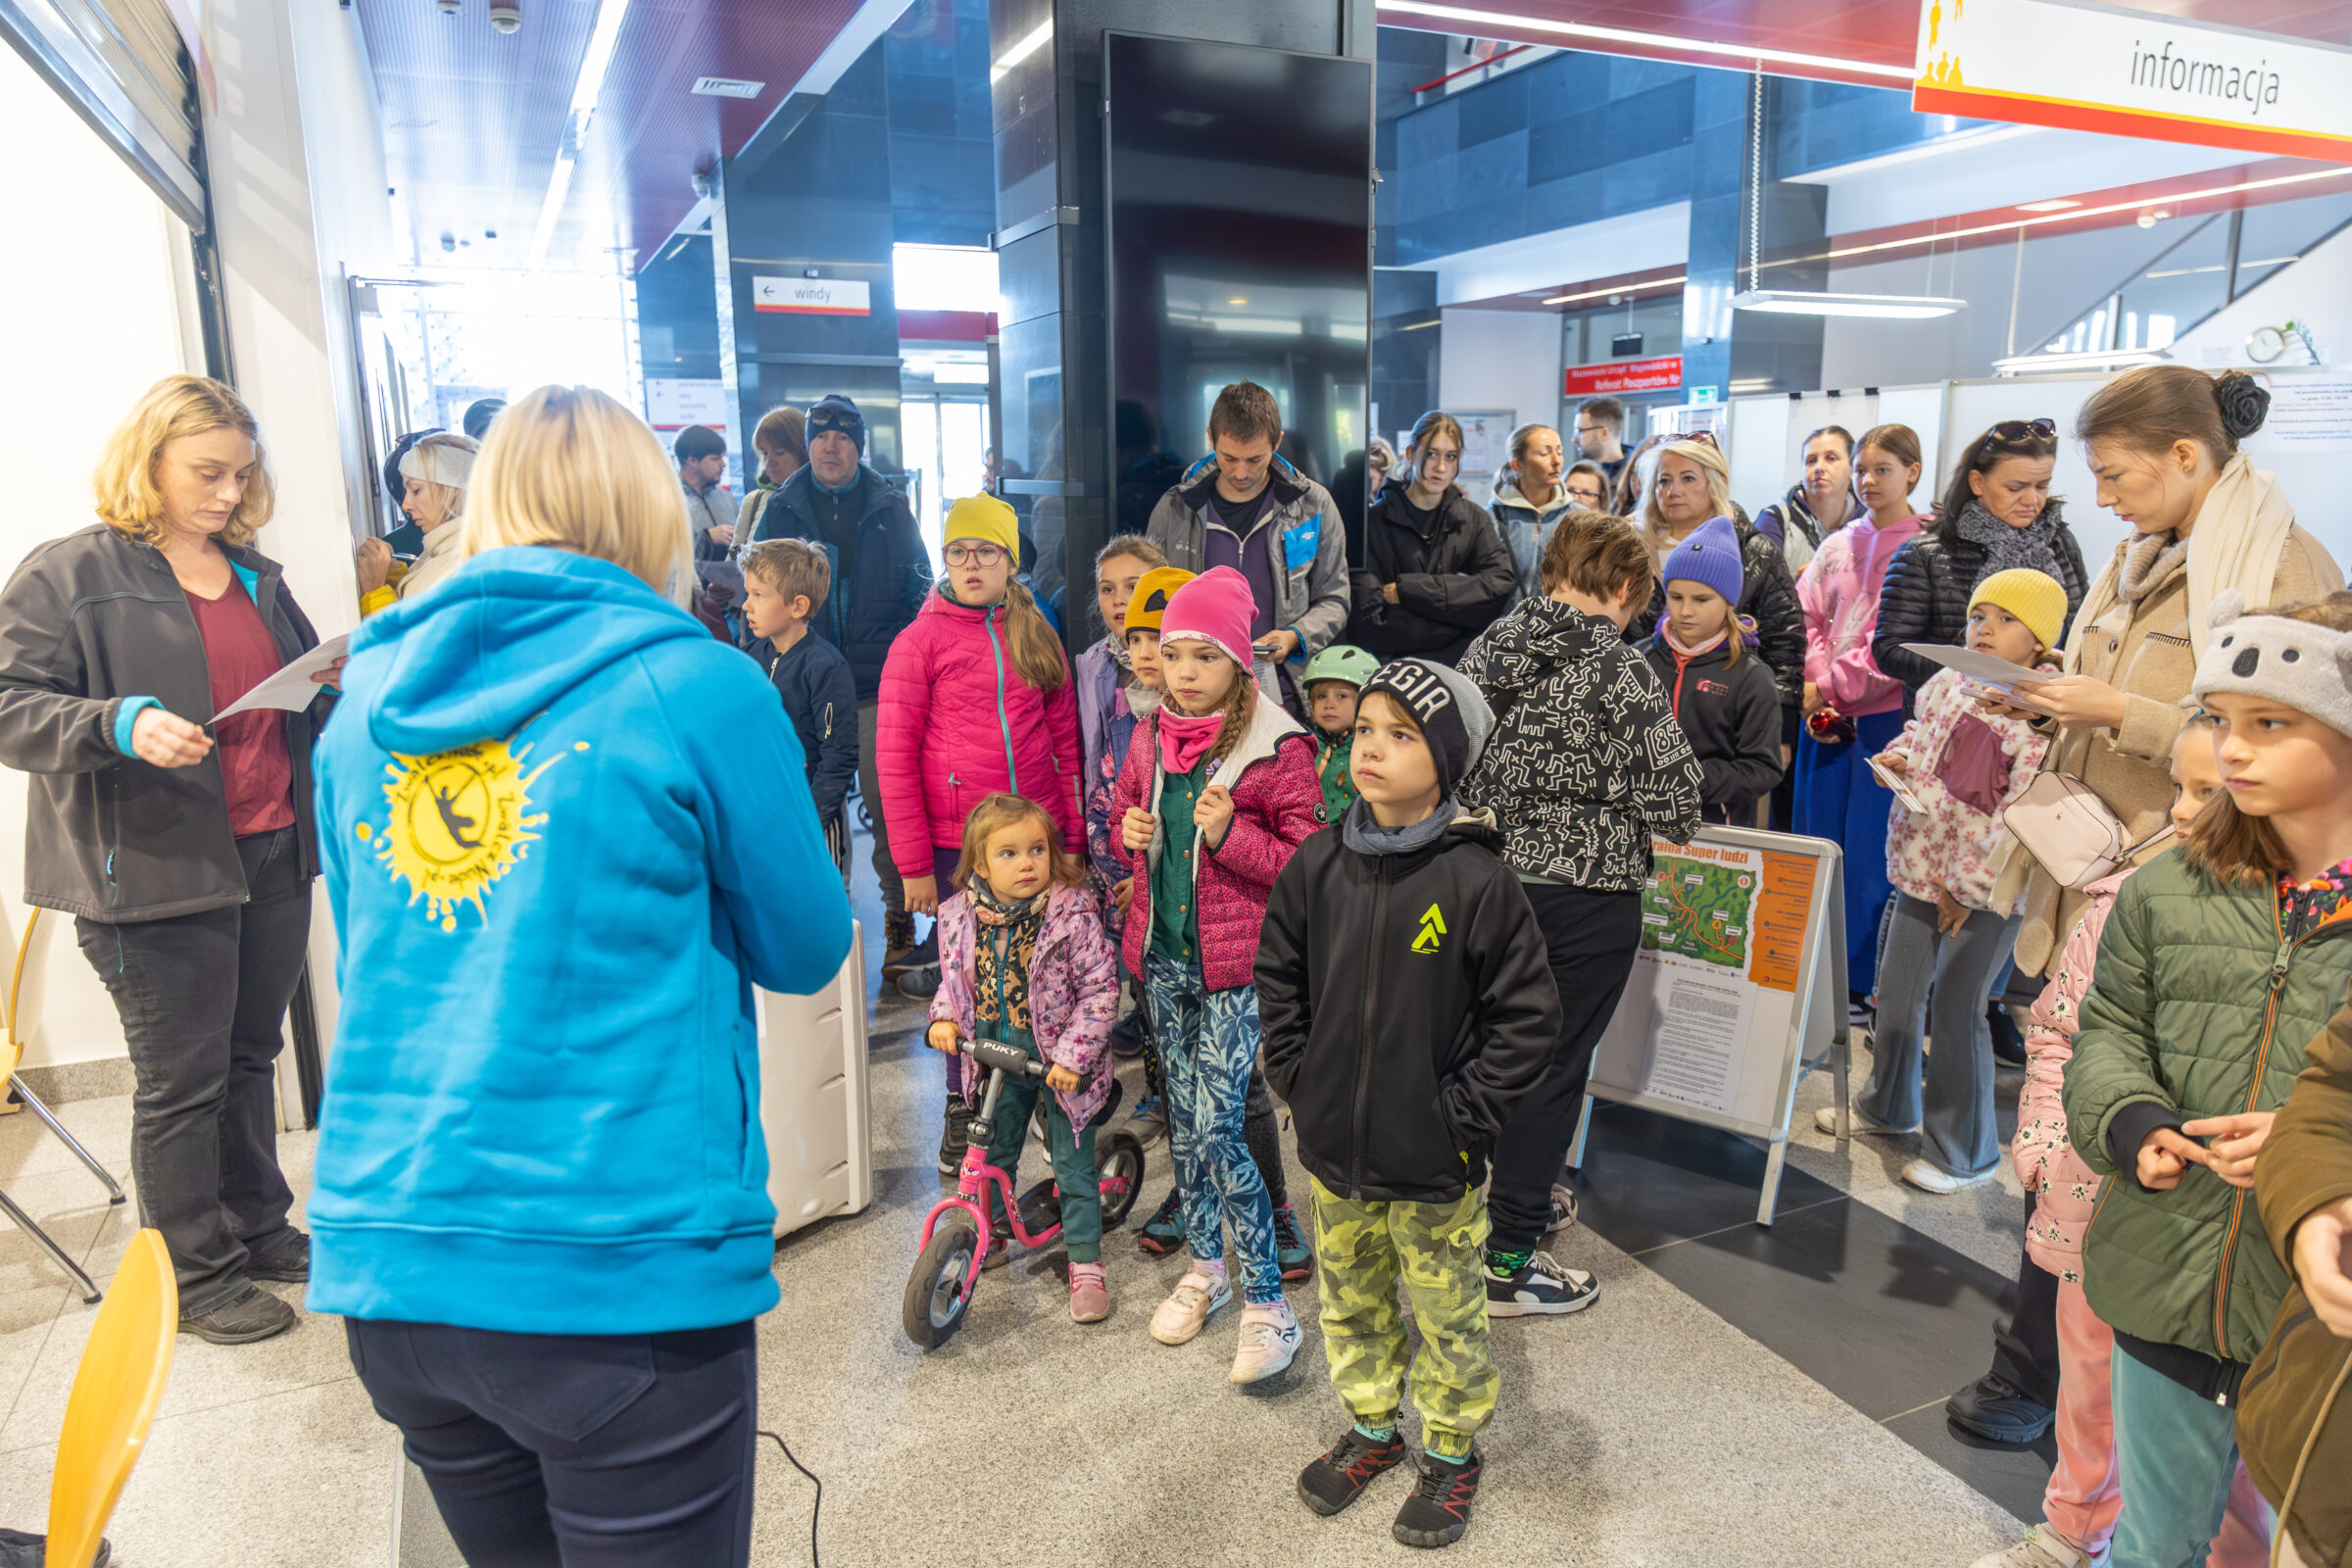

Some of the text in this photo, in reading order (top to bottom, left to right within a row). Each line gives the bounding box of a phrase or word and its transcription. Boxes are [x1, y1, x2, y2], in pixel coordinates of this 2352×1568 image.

[2131, 39, 2280, 116] informacja
[794, 286, 832, 304] windy
[1623, 375, 1668, 389] Paszportów
[1360, 662, 1450, 723] EGIA
[1652, 841, 1749, 864] raina Super ludzi
[982, 1042, 1019, 1056] PUKY
